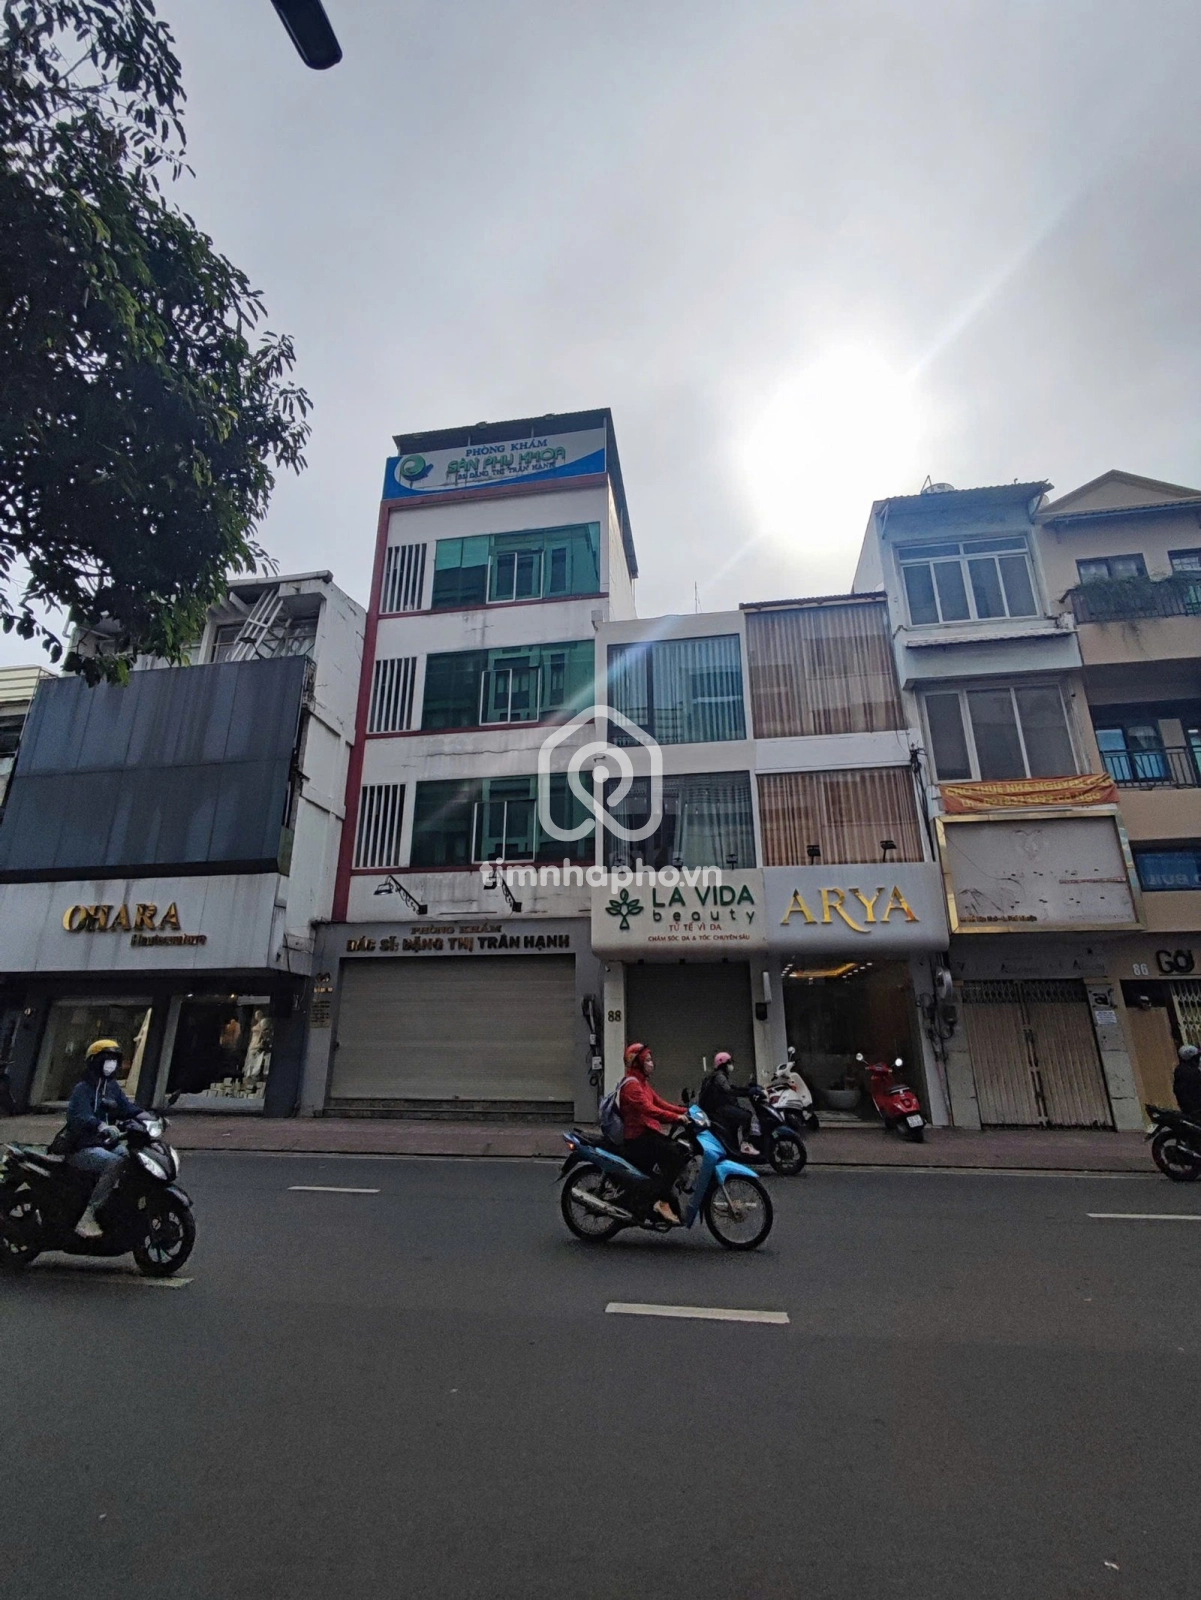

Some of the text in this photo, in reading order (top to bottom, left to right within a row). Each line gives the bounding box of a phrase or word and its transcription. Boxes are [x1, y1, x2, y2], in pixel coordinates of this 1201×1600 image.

[466, 438, 548, 457] PHÒNG KHÁM
[652, 884, 754, 908] LA VIDA
[62, 902, 182, 932] OHARA
[653, 908, 754, 924] beauty
[780, 885, 919, 933] ARYA
[710, 923, 722, 931] DA
[523, 934, 570, 951] HẠNH
[1132, 963, 1149, 976] 86
[607, 1010, 622, 1023] 88
